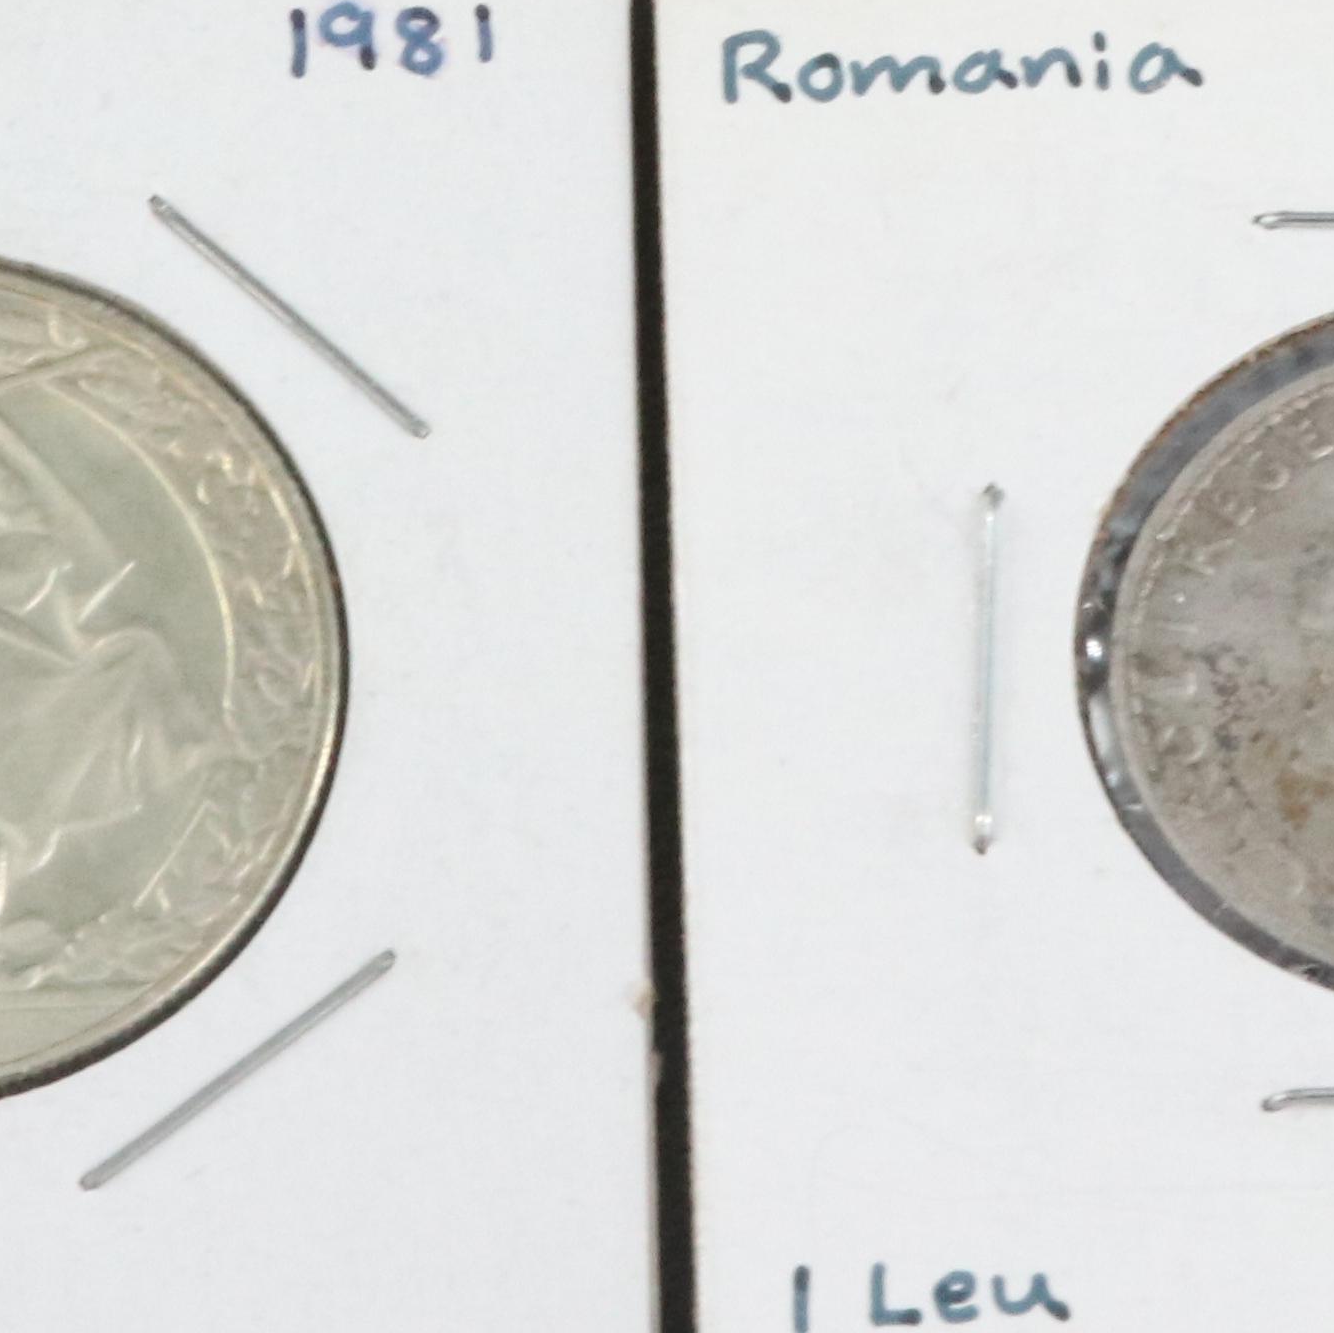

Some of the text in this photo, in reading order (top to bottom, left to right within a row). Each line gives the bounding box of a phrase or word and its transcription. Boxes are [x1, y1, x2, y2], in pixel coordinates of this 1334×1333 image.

[290, 1, 493, 78] 1981
[722, 30, 1203, 104] Romania
[869, 1263, 1071, 1326] Leu
